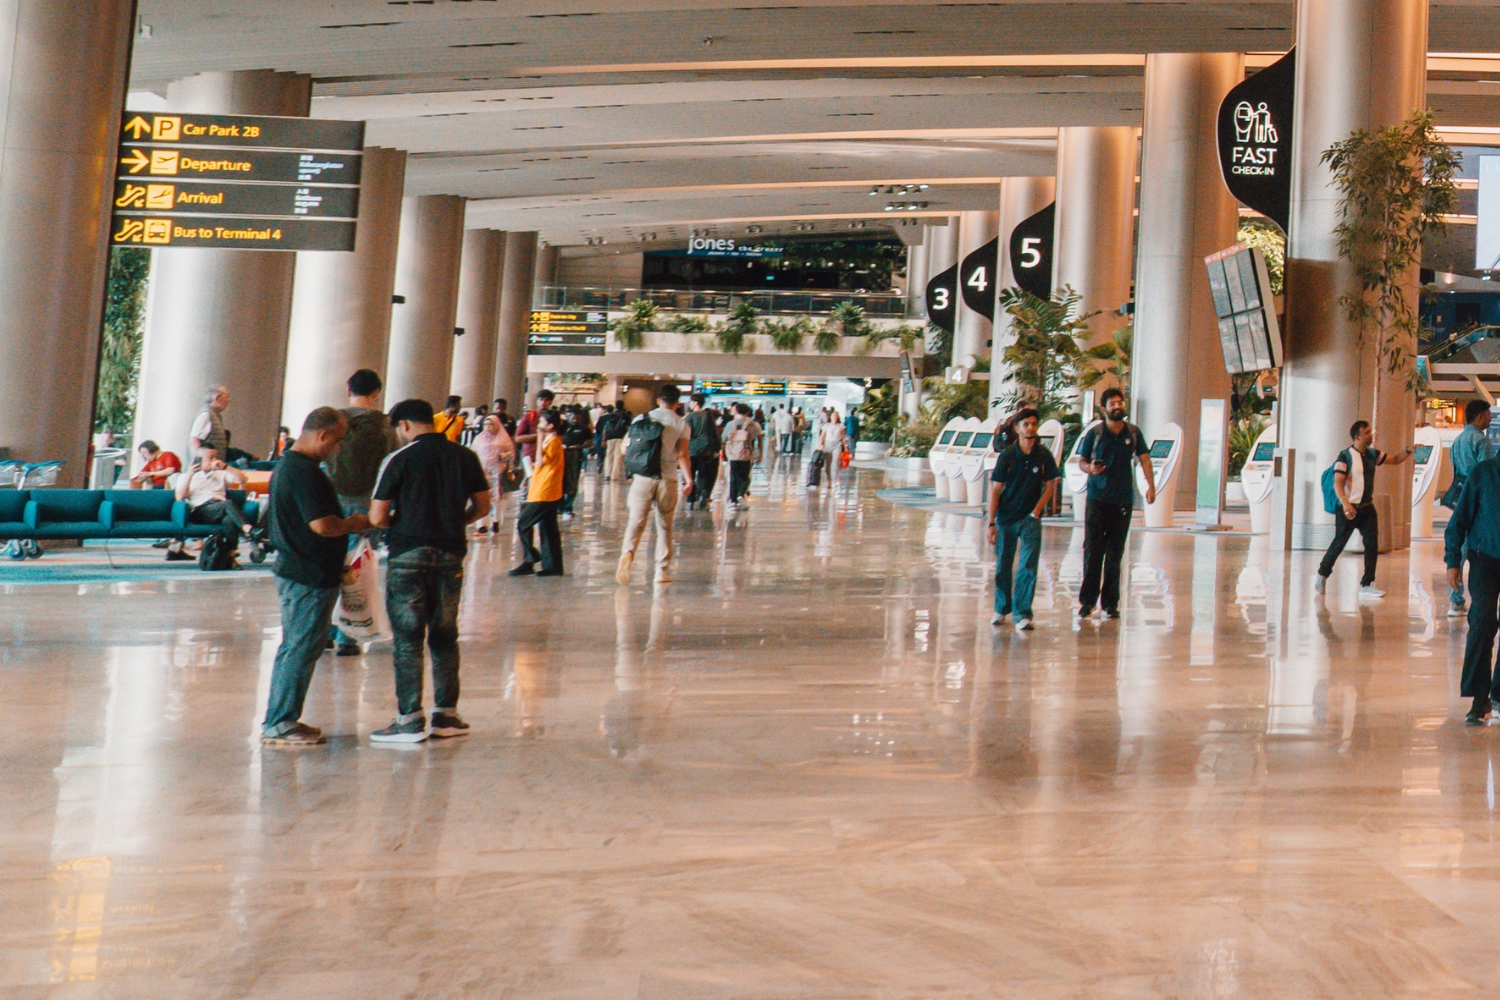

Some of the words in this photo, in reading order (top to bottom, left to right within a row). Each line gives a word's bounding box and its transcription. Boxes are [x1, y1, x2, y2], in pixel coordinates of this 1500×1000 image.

[183, 123, 205, 136] Car
[209, 124, 240, 137] Park
[242, 126, 260, 137] 2B
[1232, 147, 1278, 165] FAST
[180, 157, 252, 174] Departure
[1231, 165, 1275, 176] CHECK-IN
[177, 191, 223, 205] Arrival
[174, 226, 197, 238] Bus
[199, 227, 213, 239] to
[215, 228, 271, 240] Terminal
[272, 228, 282, 240] 4
[687, 235, 735, 255] jones
[1020, 237, 1042, 269] 5
[967, 266, 988, 292] 4
[932, 287, 950, 311] 3
[951, 369, 963, 382] 4
